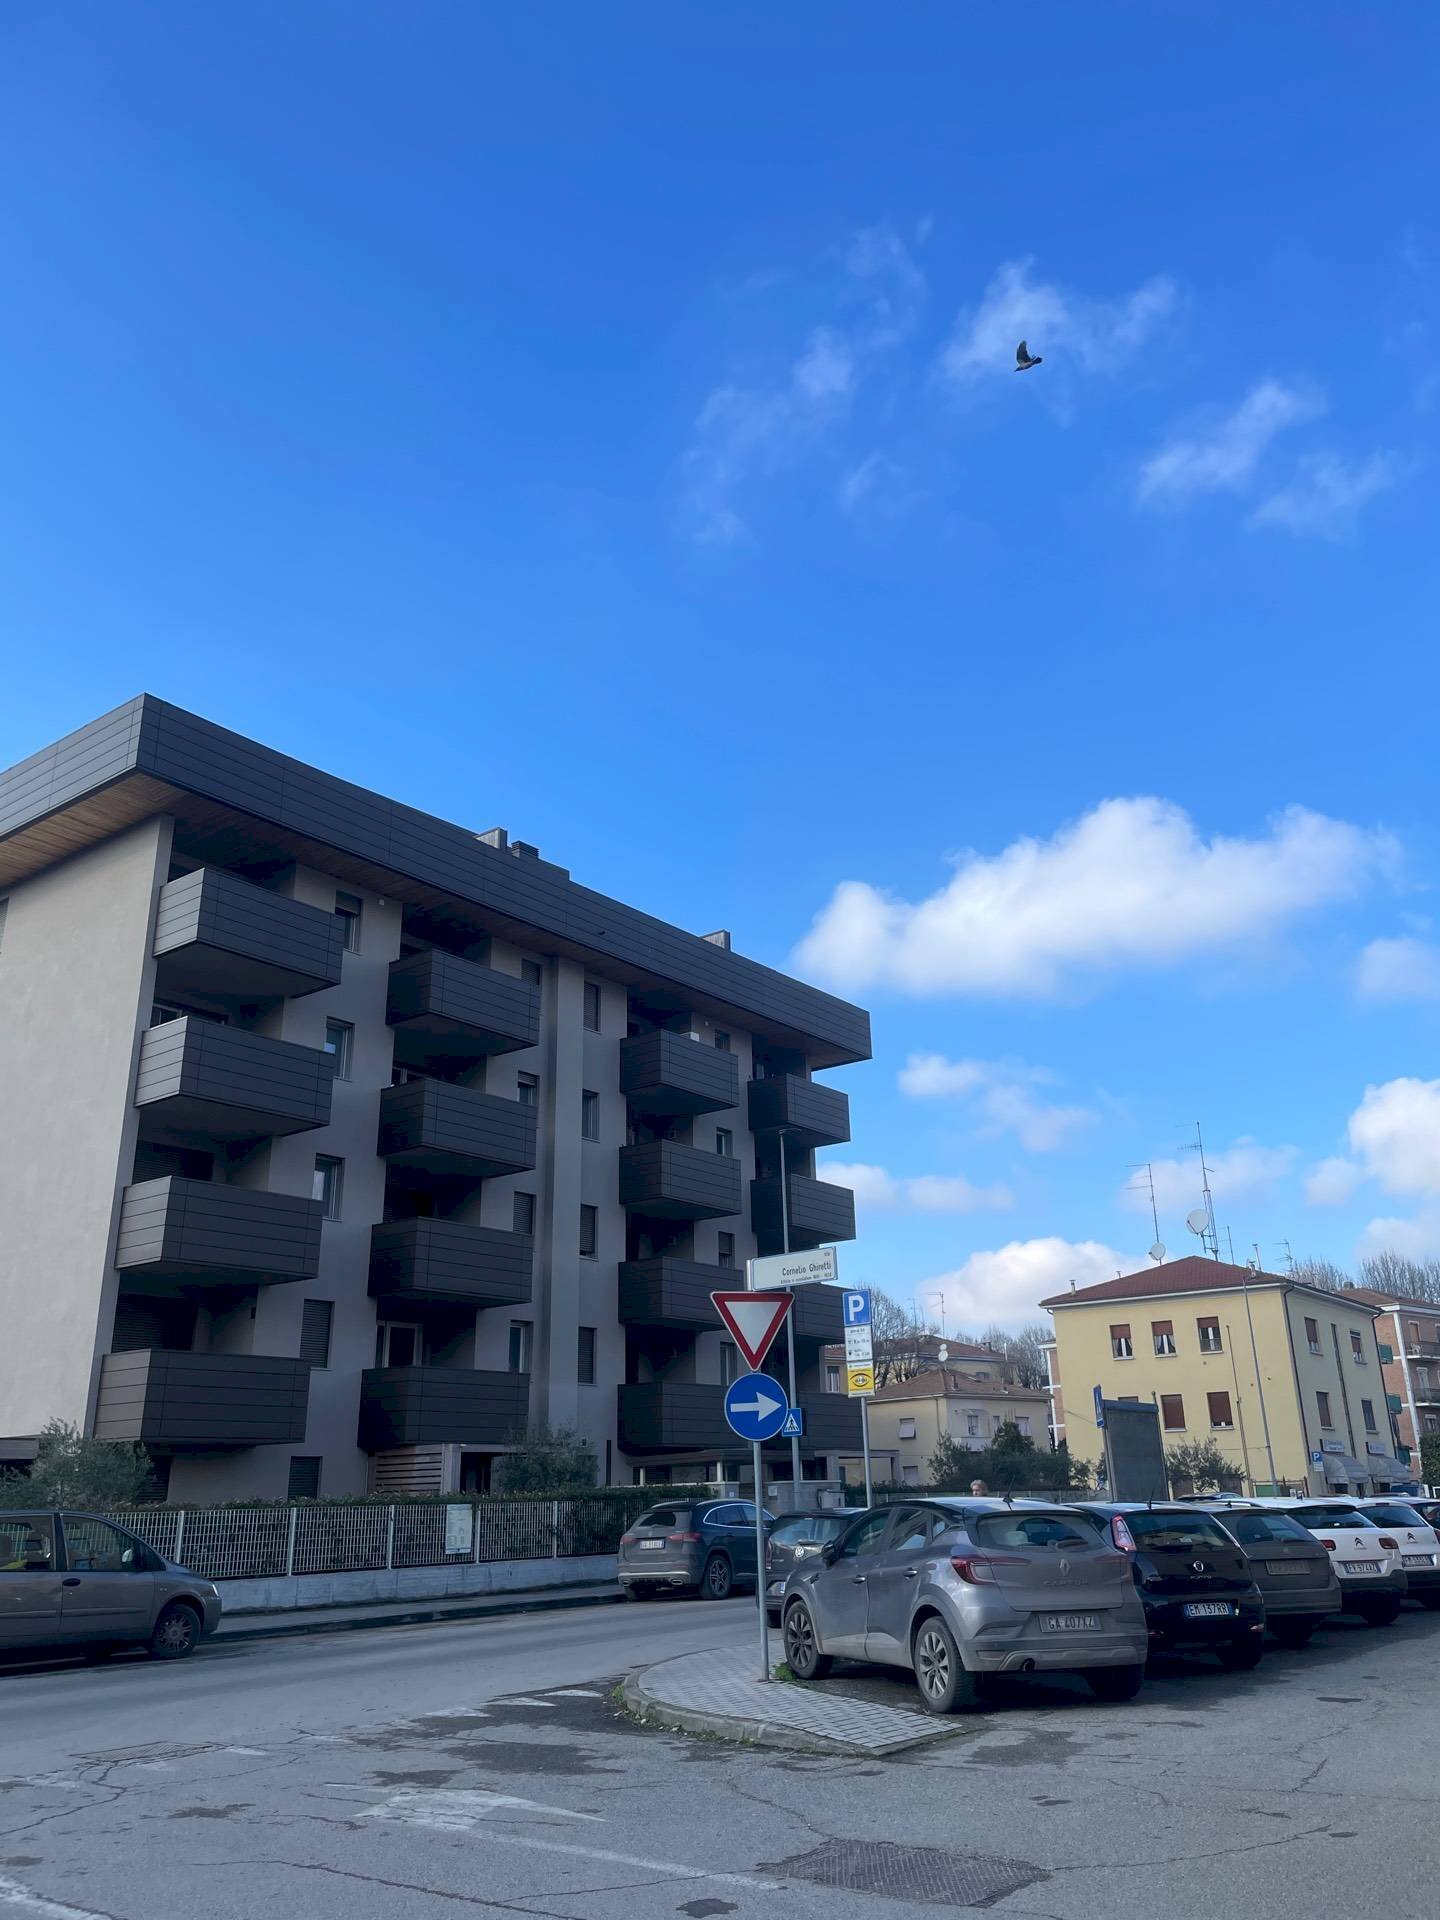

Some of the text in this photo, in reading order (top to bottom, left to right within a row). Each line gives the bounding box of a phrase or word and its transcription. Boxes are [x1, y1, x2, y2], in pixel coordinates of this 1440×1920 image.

[782, 1261, 832, 1276] Cornelio Ghiretti
[848, 1294, 865, 1321] P
